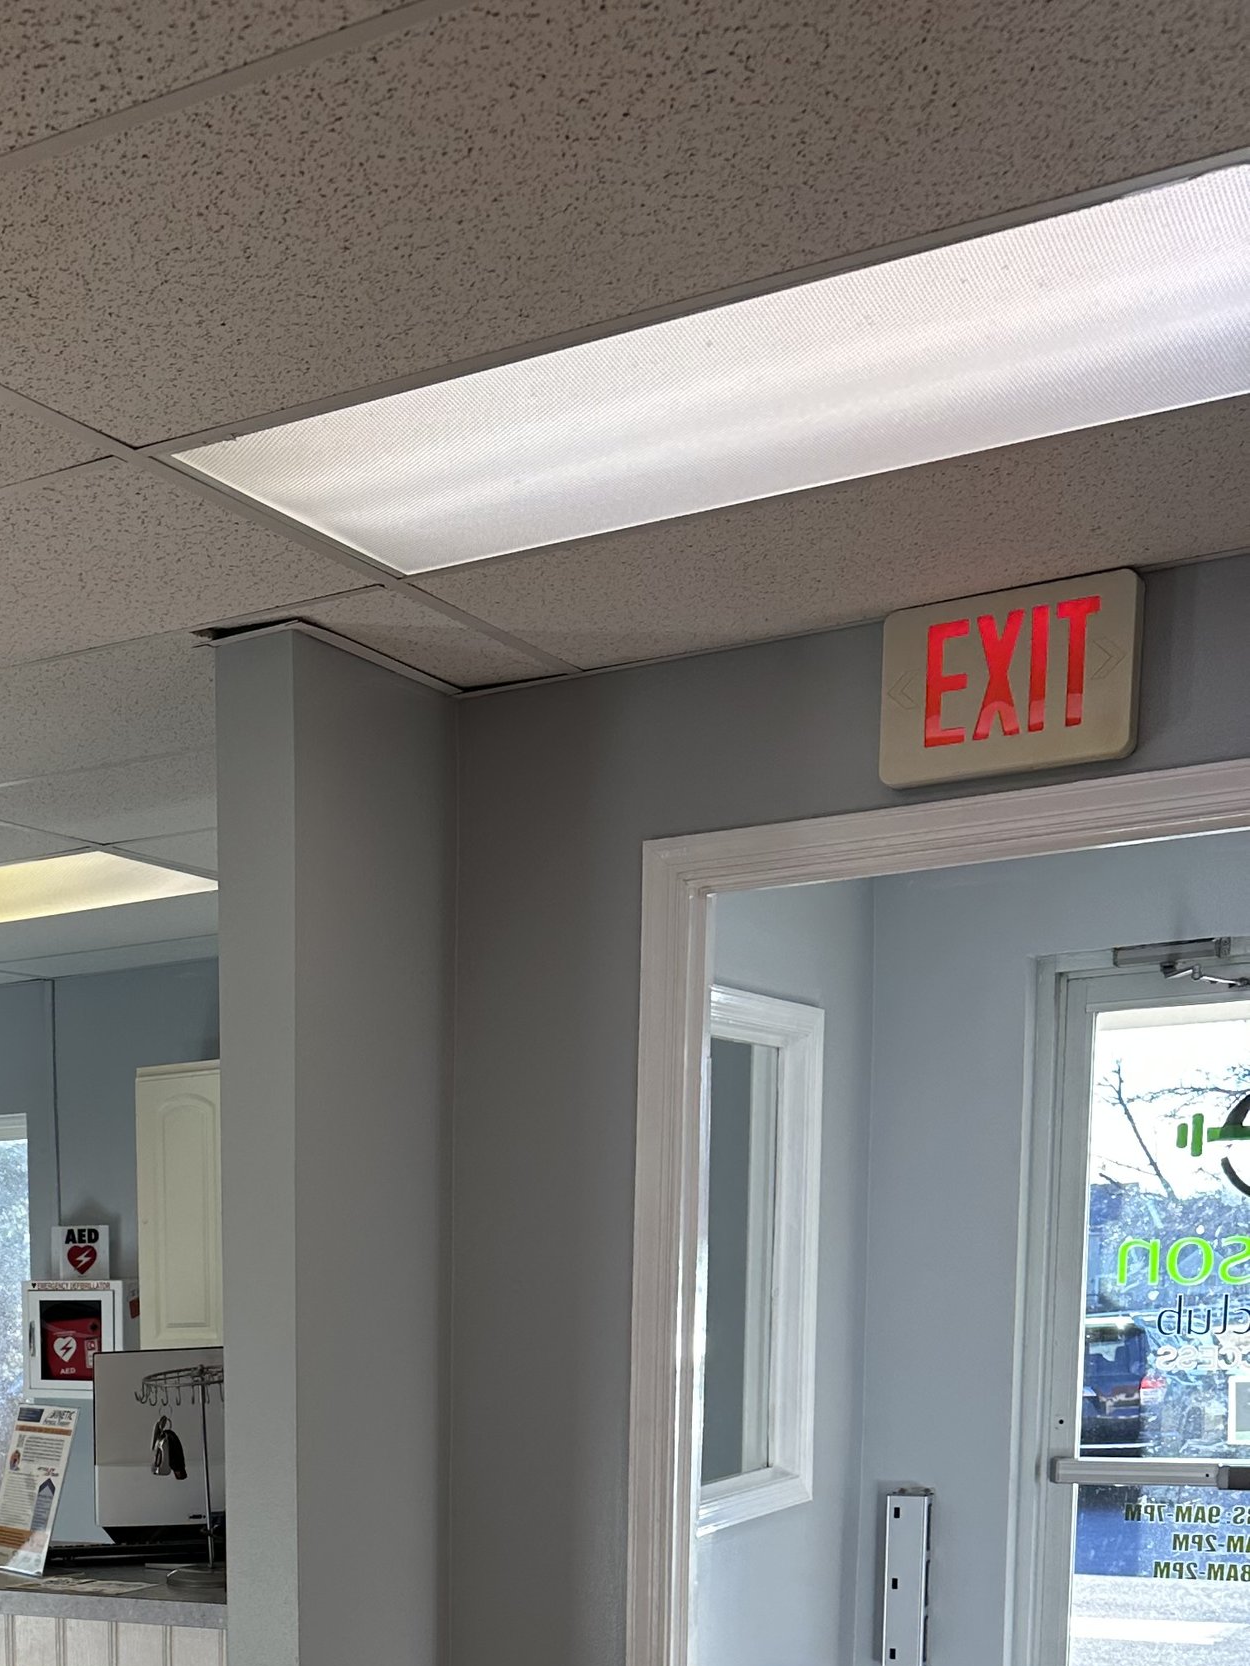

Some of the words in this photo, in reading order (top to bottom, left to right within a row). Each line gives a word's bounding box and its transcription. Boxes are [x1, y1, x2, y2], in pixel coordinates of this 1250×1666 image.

[924, 595, 1101, 748] EXIT
[65, 1228, 99, 1244] AED
[60, 1367, 76, 1375] AED
